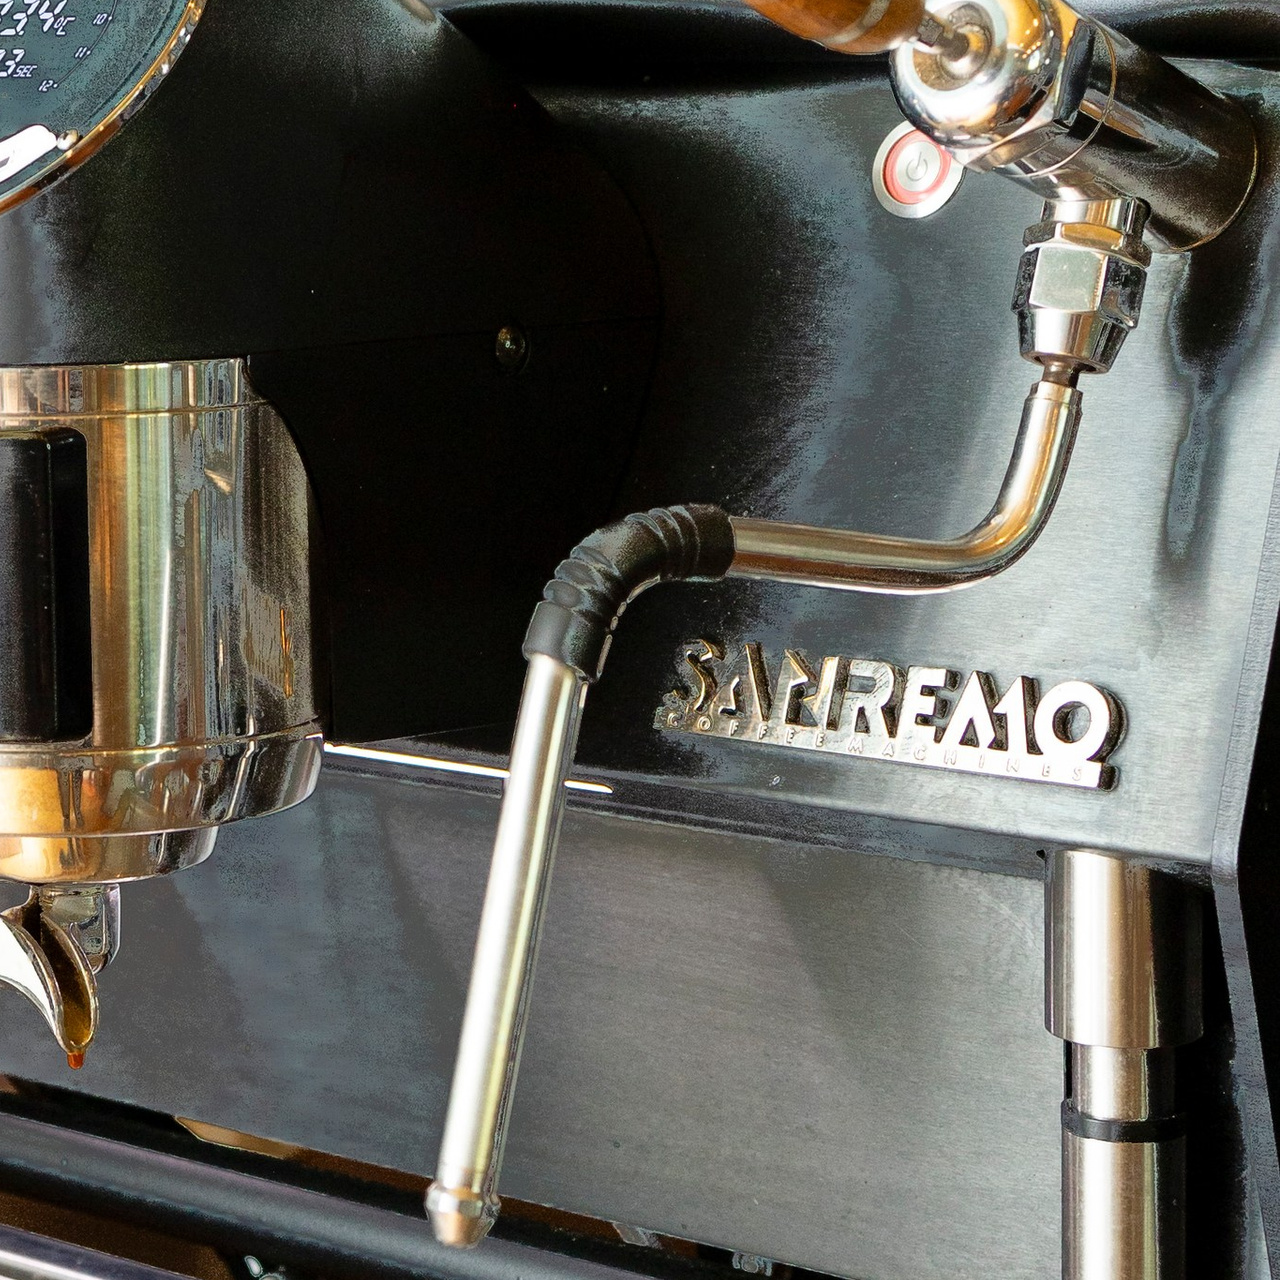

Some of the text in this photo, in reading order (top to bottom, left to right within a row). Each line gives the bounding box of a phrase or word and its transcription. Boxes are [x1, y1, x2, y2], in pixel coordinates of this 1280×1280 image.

[92, 12, 108, 25] 10
[73, 46, 88, 58] 11
[38, 79, 54, 92] 12
[664, 638, 1110, 762] SANREMO
[667, 711, 1084, 783] COFFEE MACHINES
